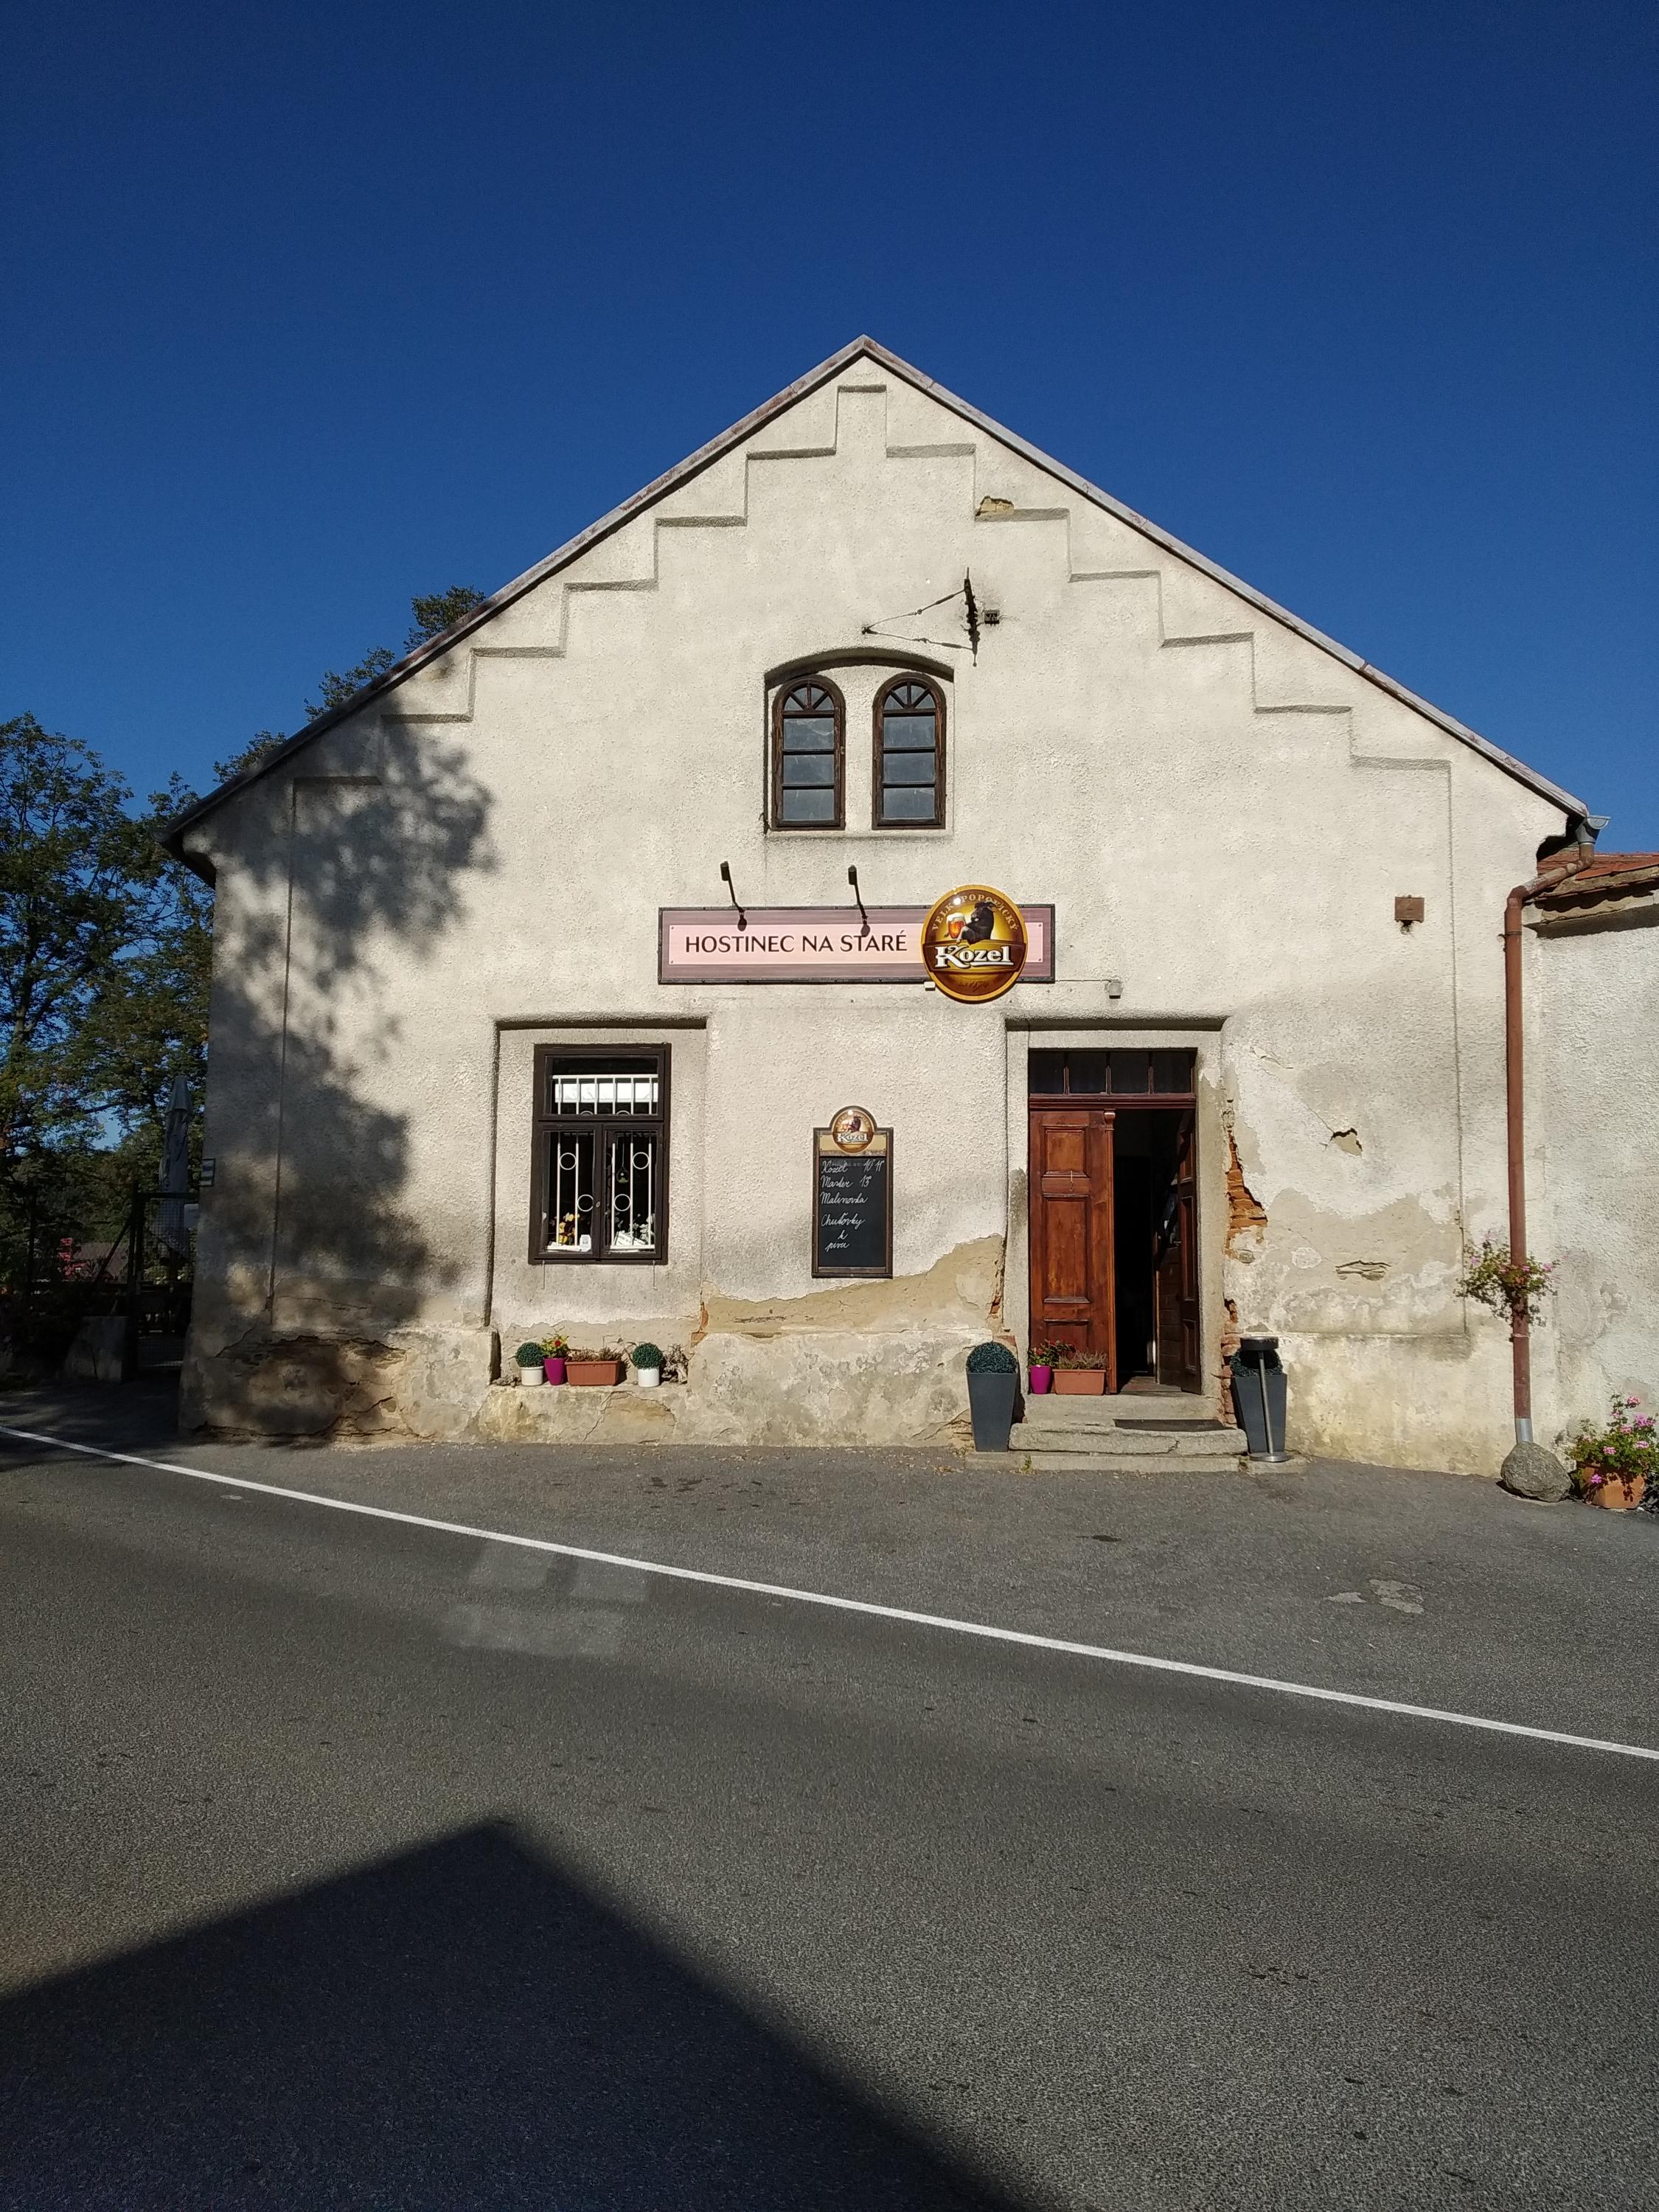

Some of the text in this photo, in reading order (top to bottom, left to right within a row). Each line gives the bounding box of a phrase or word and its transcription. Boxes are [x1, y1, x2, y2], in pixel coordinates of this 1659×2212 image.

[932, 894, 1018, 931] VELKPOPOVICKÝ
[686, 930, 908, 953] HOSTINEC NA STARÉ
[935, 945, 1014, 968] Kozel
[838, 1131, 869, 1143] Kozel
[821, 1160, 849, 1174] Kozel
[821, 1175, 853, 1188] Master
[820, 1191, 869, 1205] Malinovka
[837, 1229, 849, 1240] k
